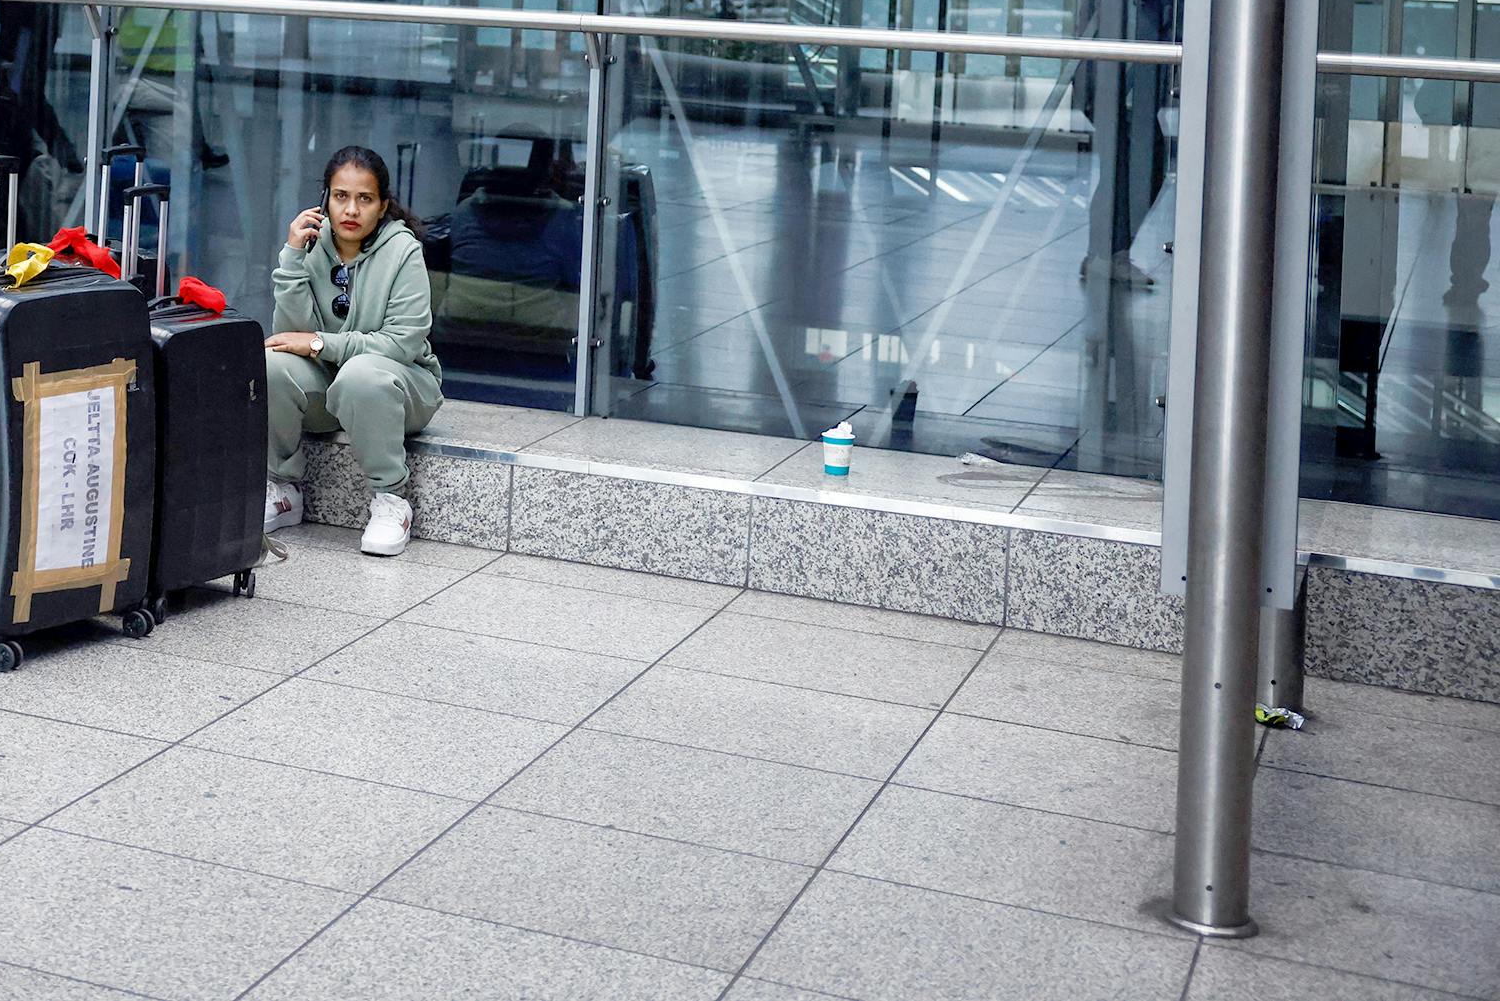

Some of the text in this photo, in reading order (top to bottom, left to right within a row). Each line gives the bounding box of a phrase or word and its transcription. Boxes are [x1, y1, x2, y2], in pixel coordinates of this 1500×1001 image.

[63, 436, 77, 478] COK
[80, 390, 101, 570] JELTTA AUGUSTINE
[60, 492, 75, 532] LHR
